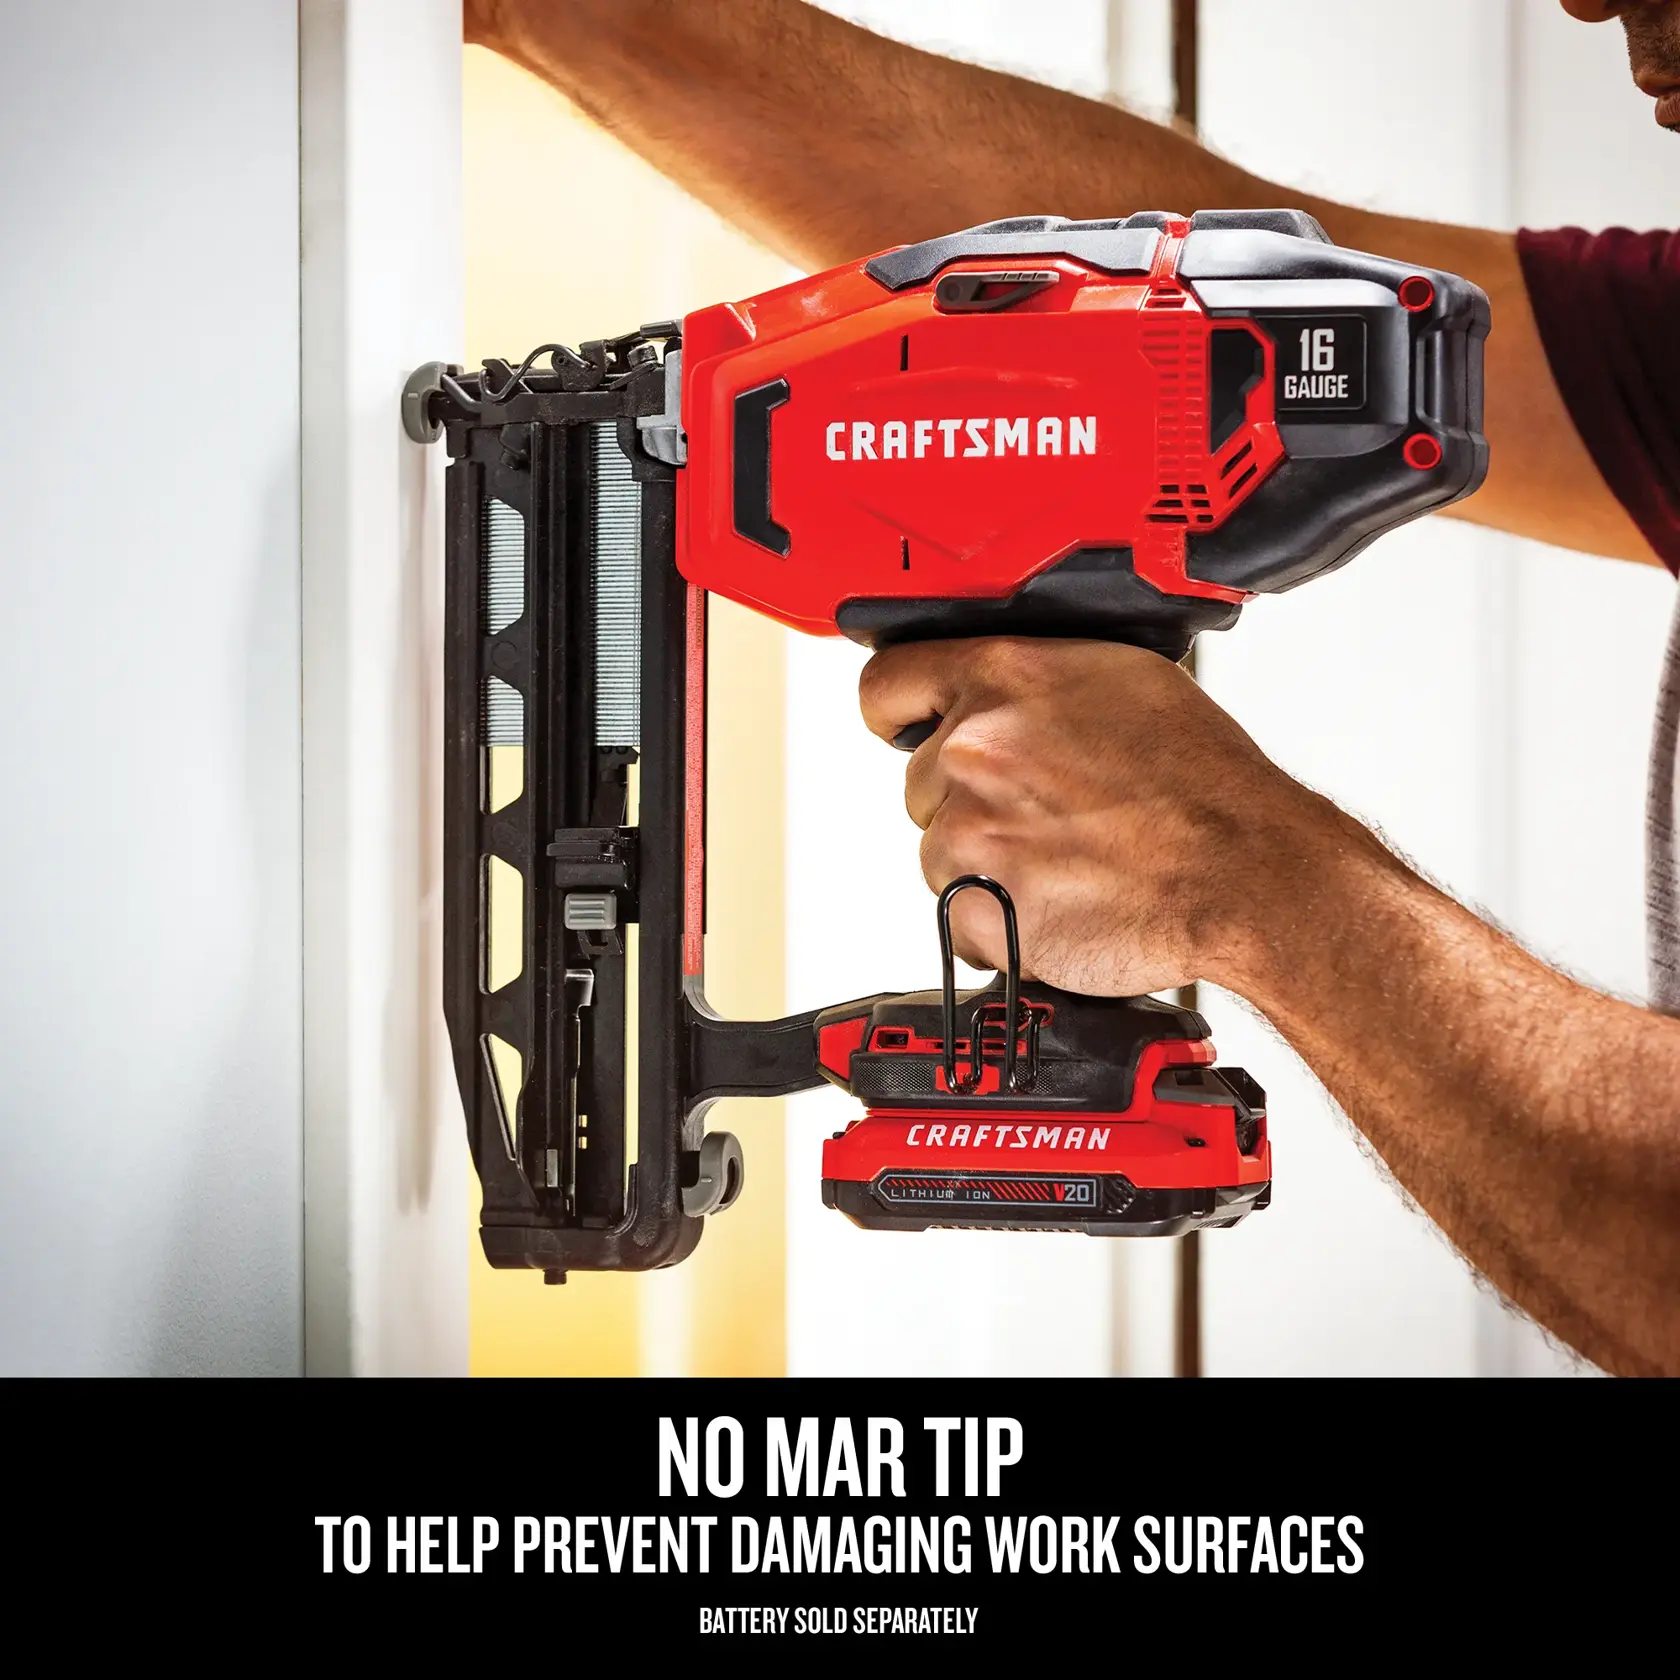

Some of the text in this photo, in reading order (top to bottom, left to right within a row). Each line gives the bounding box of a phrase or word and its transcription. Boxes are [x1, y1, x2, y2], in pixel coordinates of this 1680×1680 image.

[1300, 328, 1334, 371] 16
[1284, 374, 1348, 399] GAUGE
[826, 416, 1097, 461] CRAFTSMAN
[907, 1124, 1111, 1150] CRAFTSMAN
[891, 1183, 1089, 1202] LITHIUM ION V20
